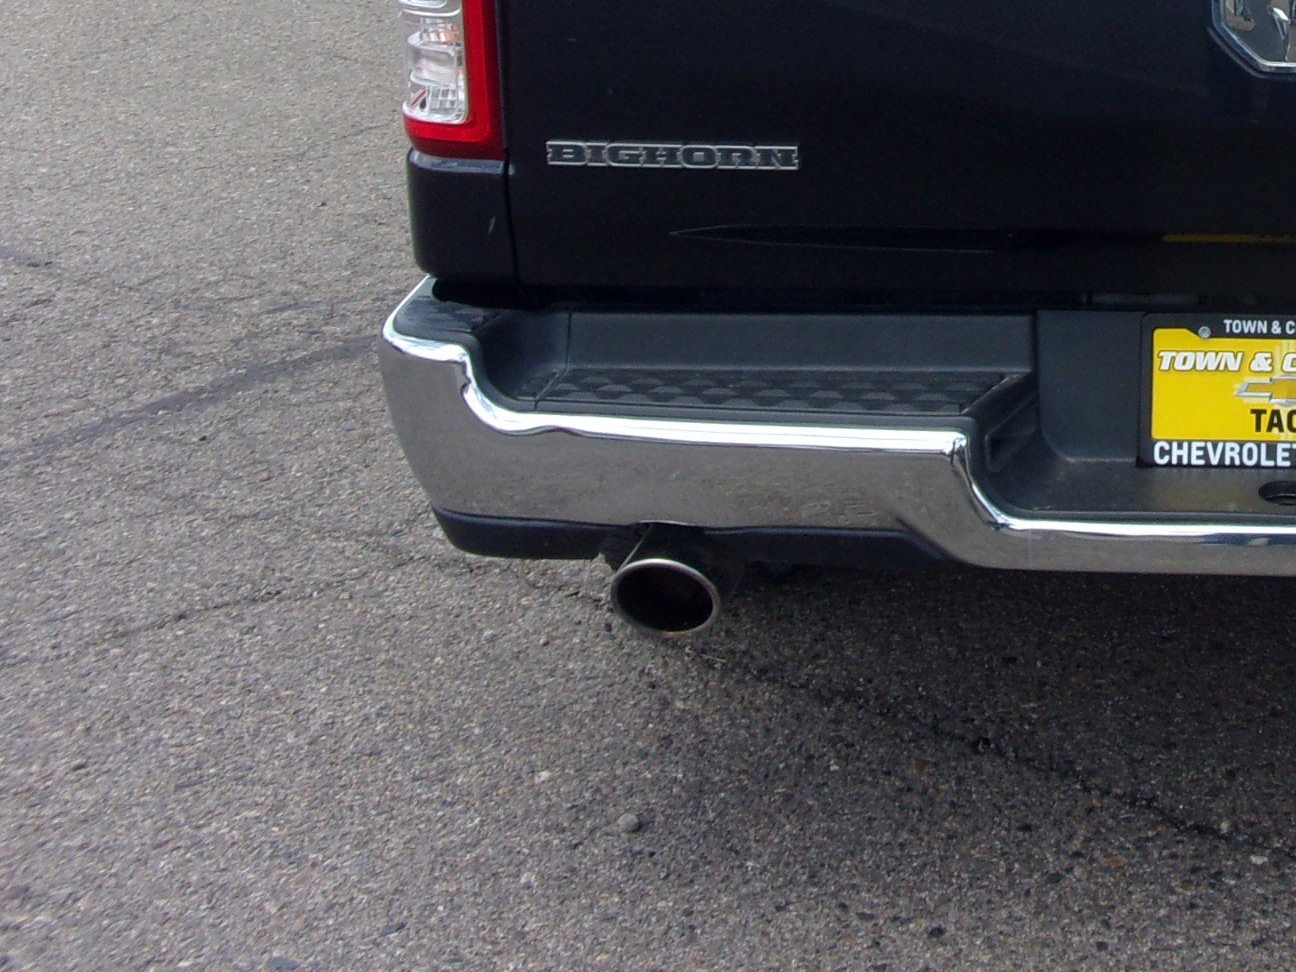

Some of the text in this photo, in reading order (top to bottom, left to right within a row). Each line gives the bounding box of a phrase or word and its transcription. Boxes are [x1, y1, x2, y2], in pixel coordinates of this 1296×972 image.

[1223, 319, 1269, 334] TOWN
[1271, 321, 1282, 334] &
[1158, 350, 1245, 372] TOWN
[1249, 352, 1274, 372] &
